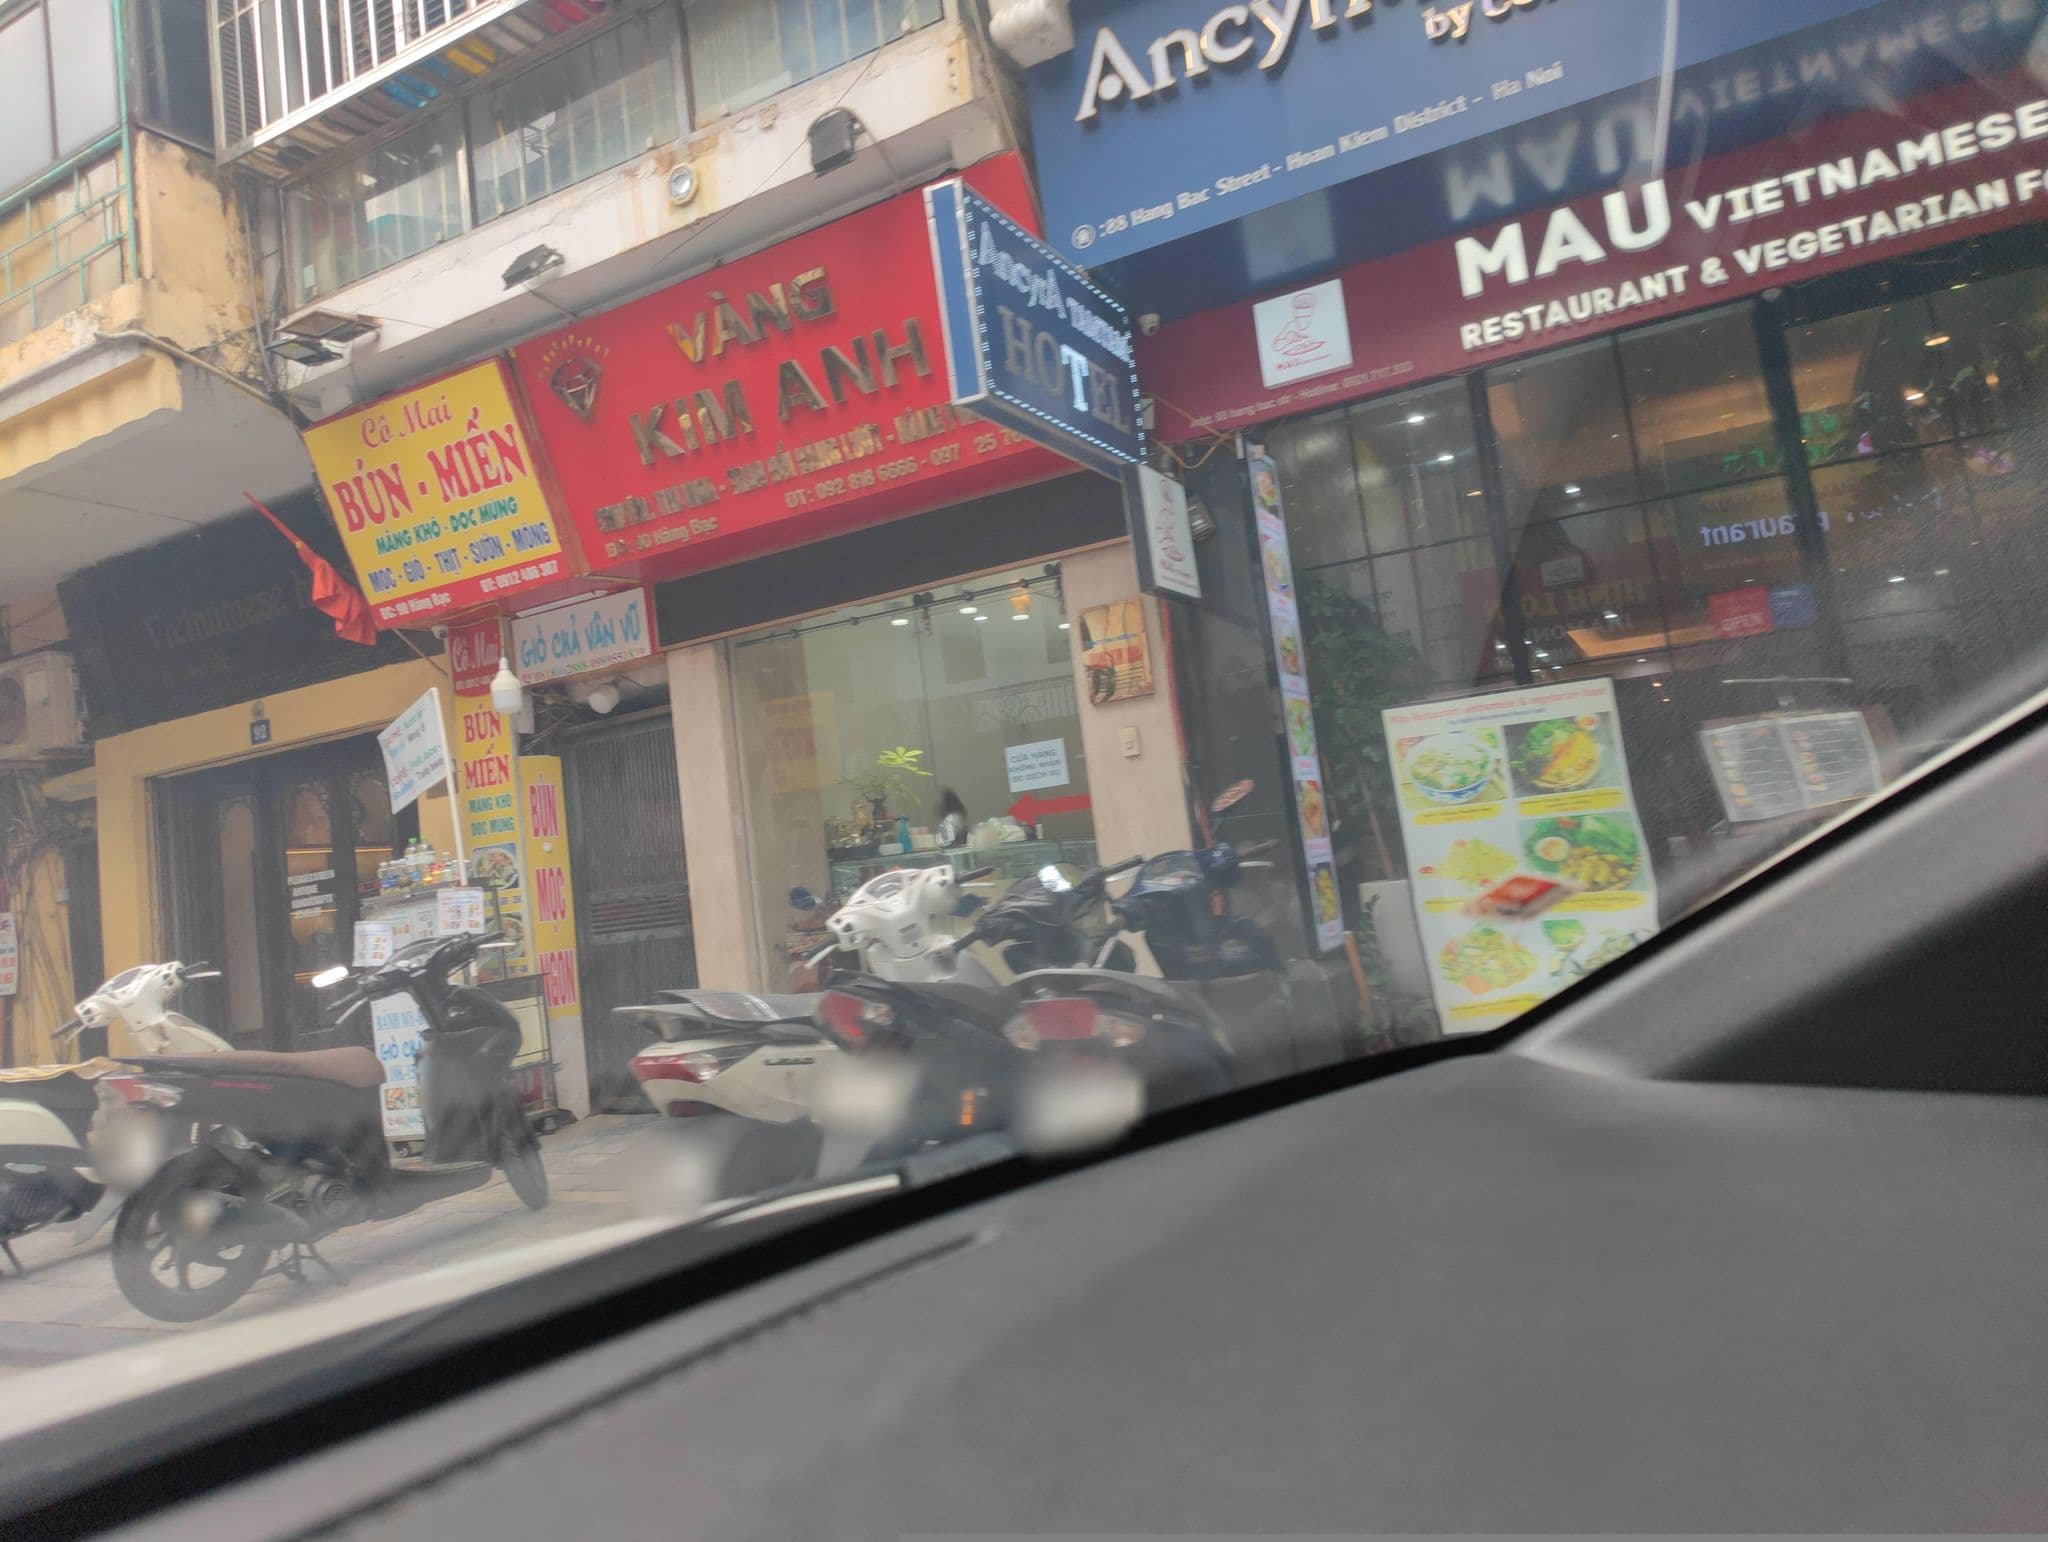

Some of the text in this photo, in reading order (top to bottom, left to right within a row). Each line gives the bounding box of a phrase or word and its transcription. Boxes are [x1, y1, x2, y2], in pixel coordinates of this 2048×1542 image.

[1422, 1, 1473, 39] by
[1455, 98, 2048, 298] MAU VIETNAMESE
[1460, 265, 1689, 351] RESTAURANT
[1701, 255, 1728, 286] &
[1733, 178, 2010, 276] VEGETARIAN
[668, 266, 836, 364] VÀNG
[628, 317, 931, 466] KIM ANH
[998, 305, 1130, 435] HOTEL
[362, 395, 452, 448] Cô Mai
[332, 458, 413, 533] BÚN
[427, 407, 528, 503] MIẾN
[816, 478, 845, 499] 092
[449, 509, 477, 534] DỌC
[520, 624, 548, 668] GIÒ
[552, 613, 581, 658] CHẢ
[463, 704, 500, 743] BÚN
[464, 744, 510, 790] MIẾN
[529, 774, 559, 838] BÚN
[536, 867, 566, 934] MỌC
